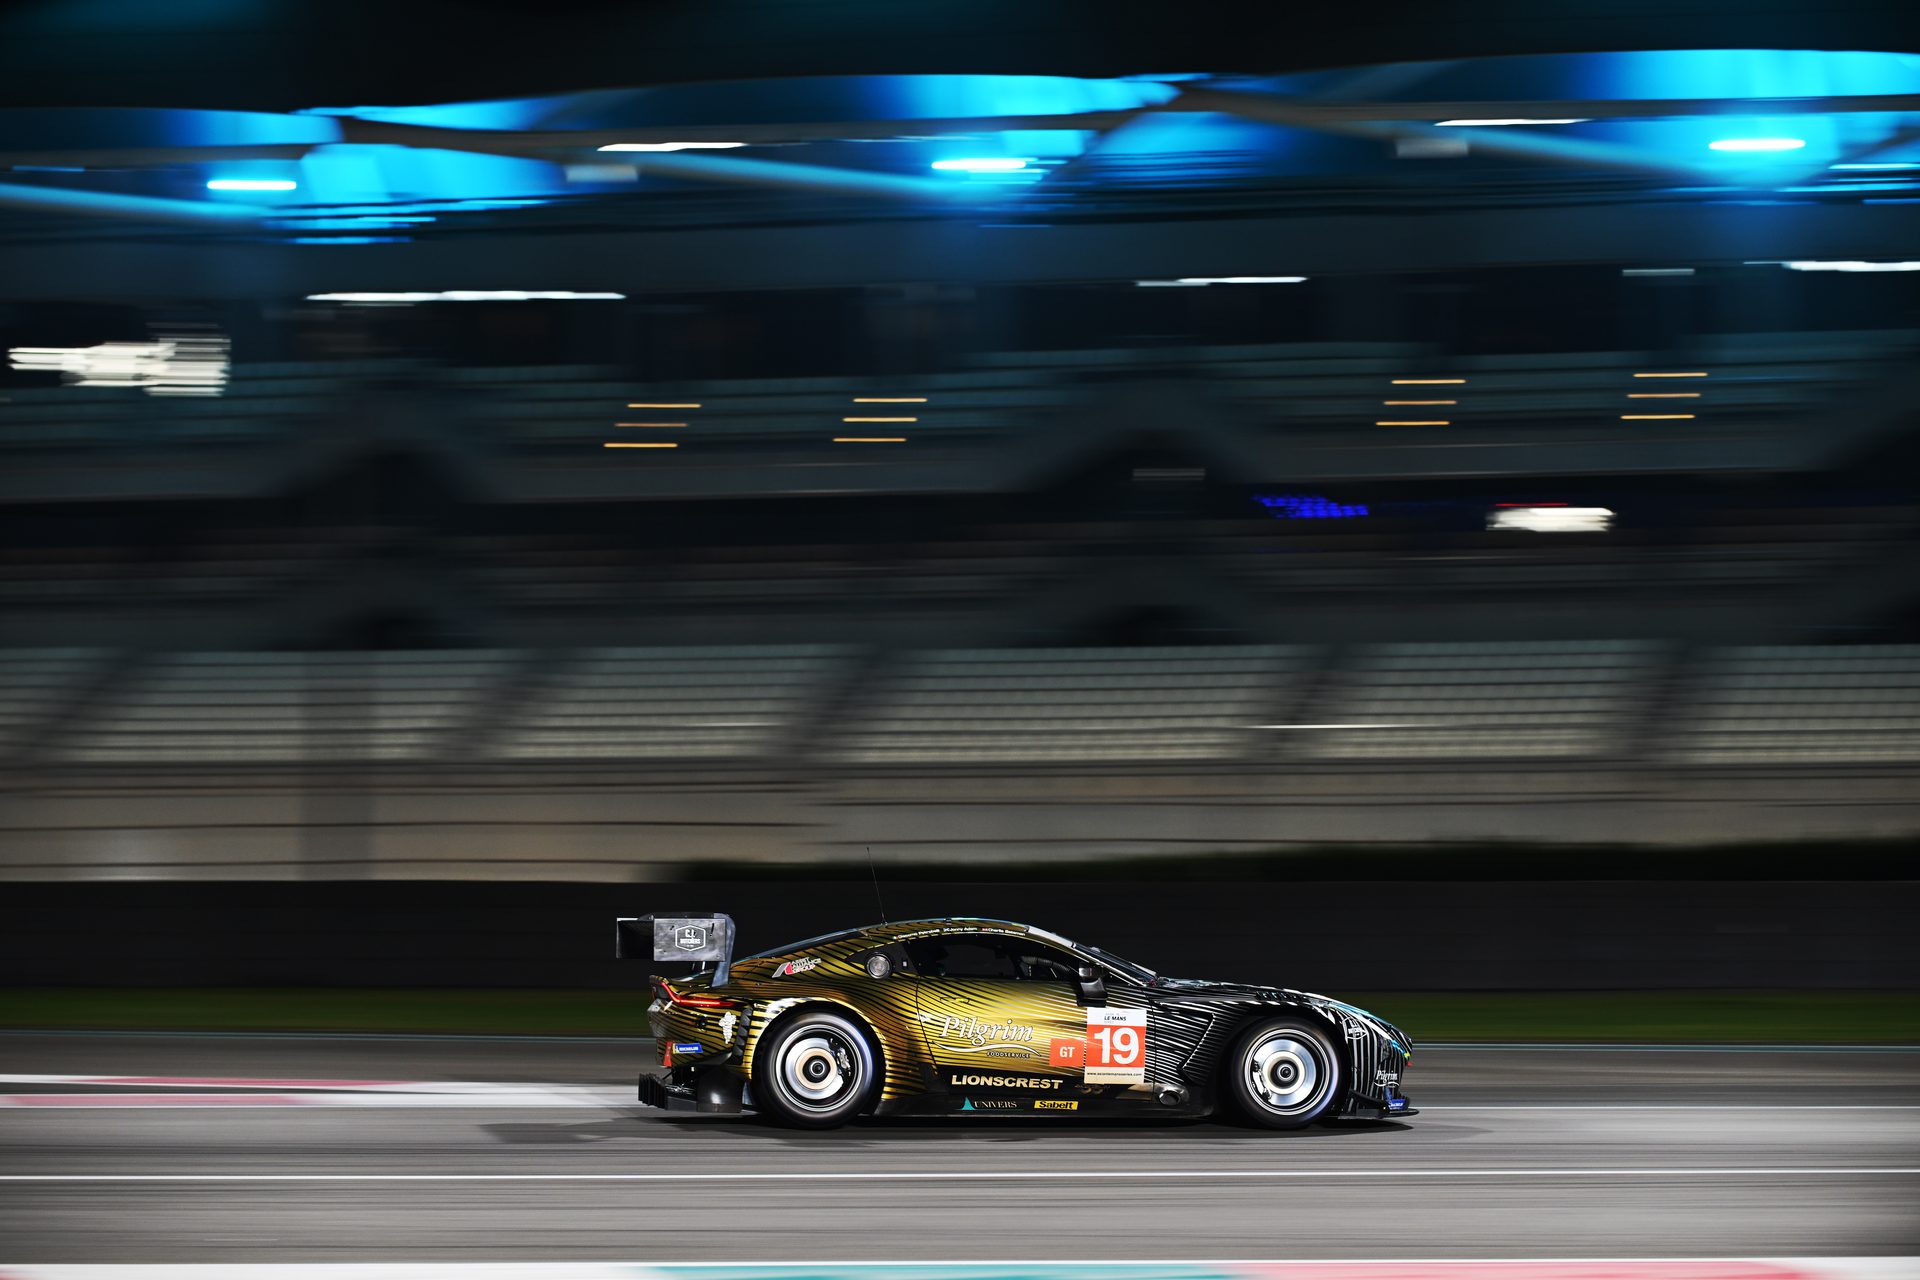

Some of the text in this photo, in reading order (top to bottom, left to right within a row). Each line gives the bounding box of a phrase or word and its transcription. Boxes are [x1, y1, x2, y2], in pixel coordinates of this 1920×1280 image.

[939, 1015, 1033, 1046] Pilgrim
[1059, 1046, 1075, 1058] GT
[1094, 1027, 1139, 1065] 19
[986, 1051, 1030, 1059] FOODSERVICE
[951, 1074, 1064, 1090] LIONSCREST
[974, 1100, 1018, 1109] UNIVERS
[1038, 1100, 1075, 1110] Sabelt
